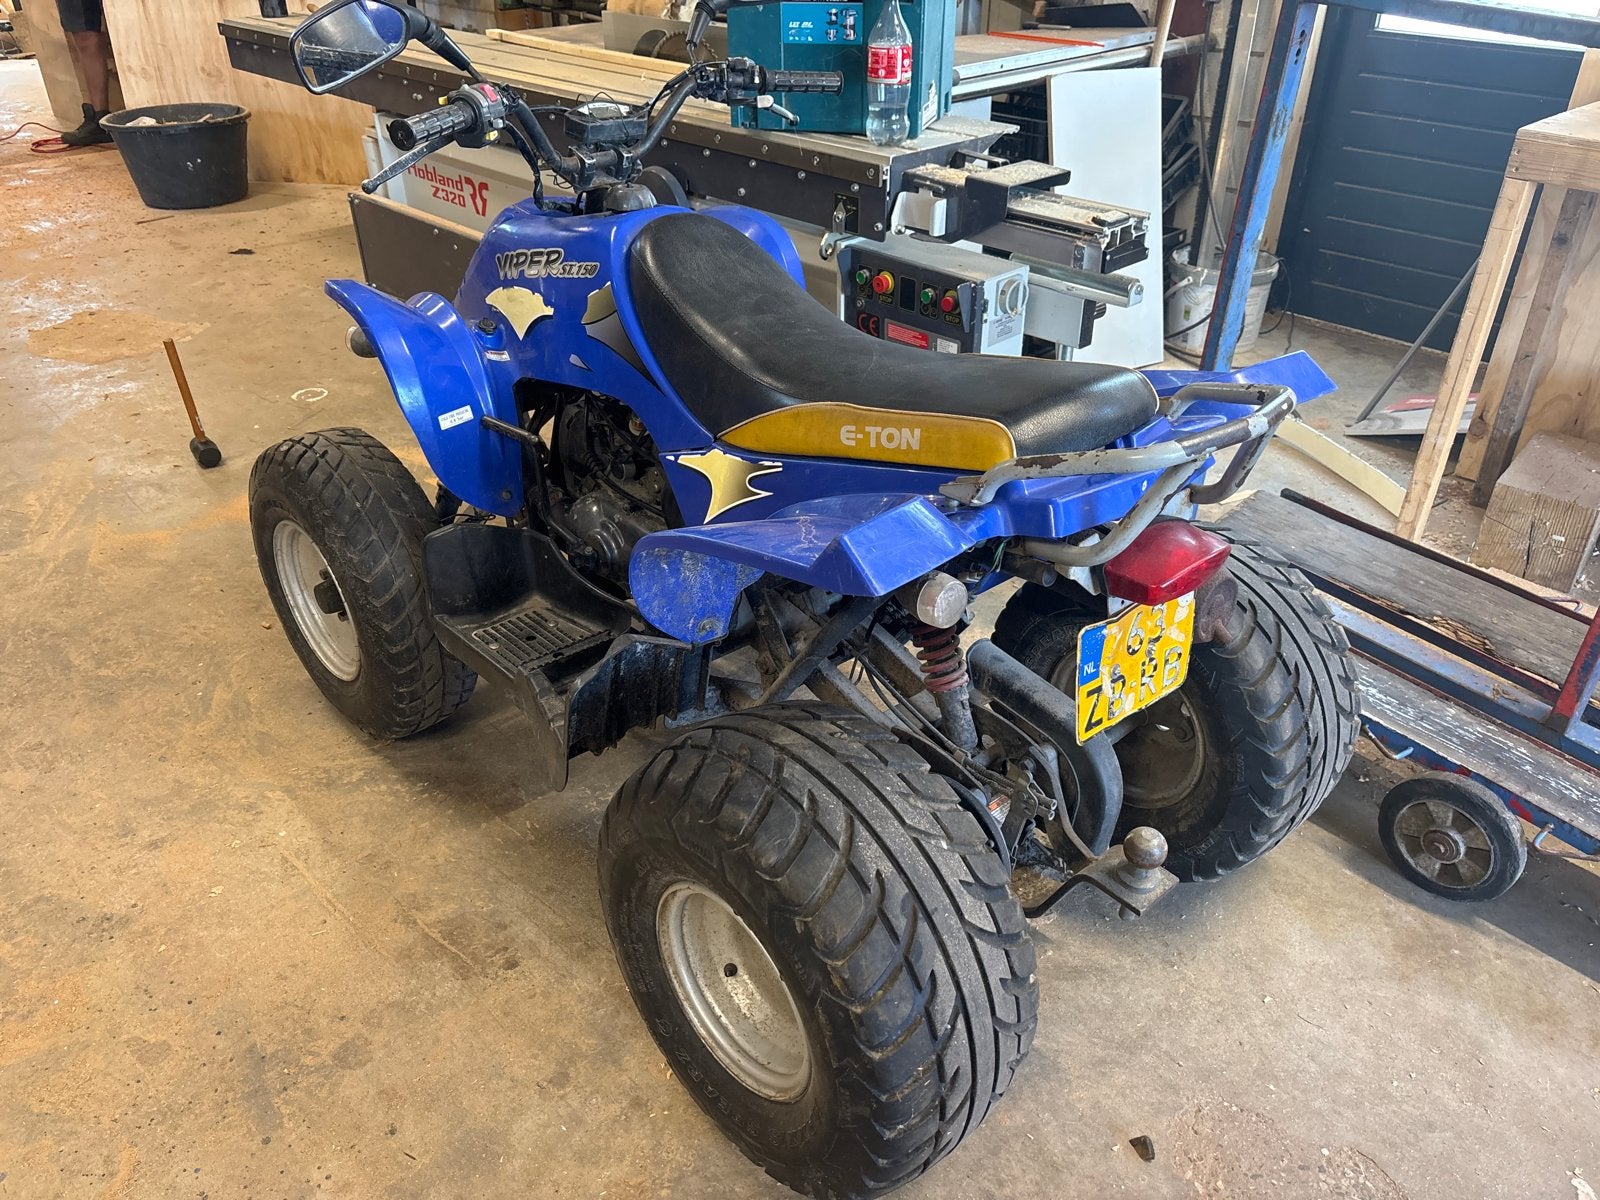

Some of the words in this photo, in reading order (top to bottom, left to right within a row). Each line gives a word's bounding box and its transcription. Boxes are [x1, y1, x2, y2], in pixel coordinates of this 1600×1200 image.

[431, 185, 466, 208] Z320
[496, 248, 564, 280] VIPER
[879, 295, 892, 303] STOP
[945, 314, 960, 324] STOP
[840, 425, 921, 450] E-TON
[1127, 602, 1166, 656] 63
[1083, 662, 1096, 677] NL
